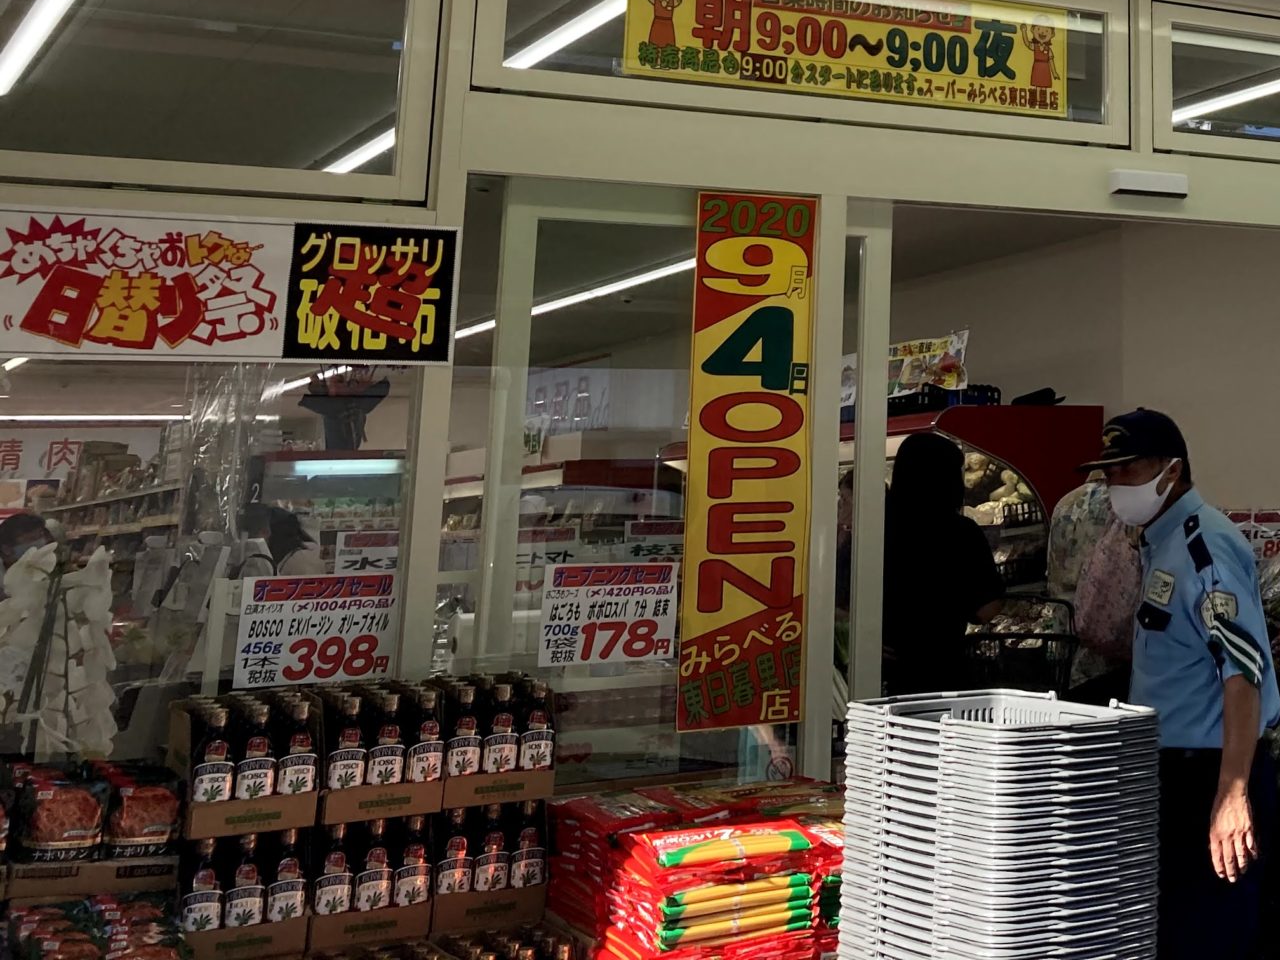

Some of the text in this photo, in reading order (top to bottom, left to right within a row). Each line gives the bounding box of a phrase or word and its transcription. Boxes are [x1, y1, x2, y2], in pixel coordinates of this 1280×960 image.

[701, 199, 811, 238] 2020
[301, 231, 444, 277] グロッサリ
[697, 391, 806, 615] OPEN
[549, 602, 581, 622] はごろも
[248, 618, 284, 638] BOSCO
[544, 624, 580, 637] 700g
[241, 641, 283, 655] 456g
[680, 612, 802, 677] みらべる
[242, 656, 281, 669] 1本
[550, 650, 575, 663] 税抜
[248, 669, 277, 684] 税抜
